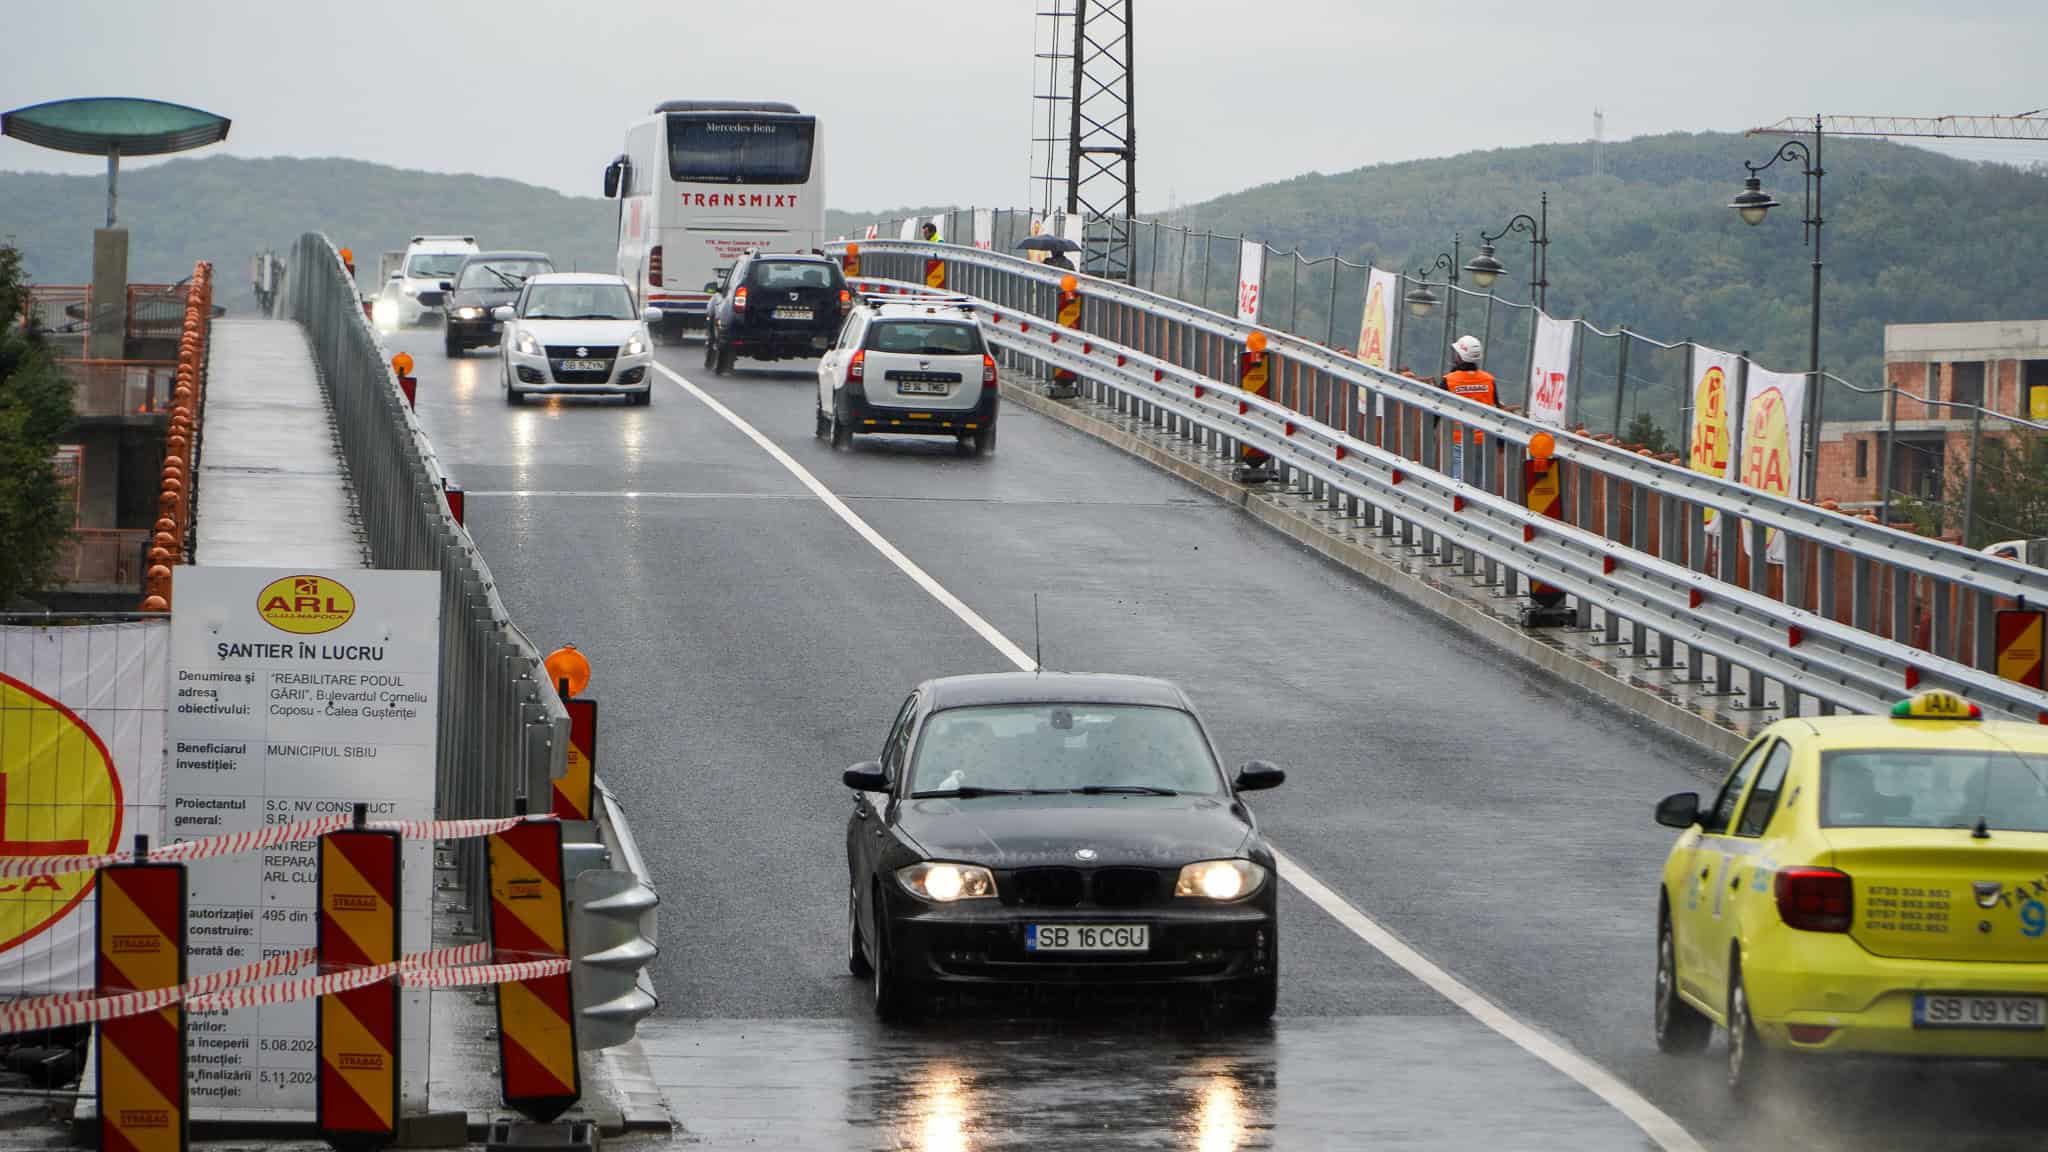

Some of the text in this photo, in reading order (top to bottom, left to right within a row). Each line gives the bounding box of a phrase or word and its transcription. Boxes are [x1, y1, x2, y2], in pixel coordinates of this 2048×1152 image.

[706, 122, 776, 134] Mercedes-Benz
[682, 192, 798, 208] TRANSMIXT
[263, 596, 349, 614] ARL
[298, 641, 316, 659] ÎN
[323, 646, 384, 661] LUCRU
[178, 671, 242, 683] Denumirea
[361, 675, 404, 687] PODUL
[178, 687, 217, 698] adresa
[316, 690, 376, 702] Bulevardul
[379, 692, 428, 703] Corneliu
[178, 703, 250, 715] obiectivului:
[270, 705, 314, 717] Coposu
[325, 705, 358, 717] Calea
[177, 743, 246, 754] Beneficiarul
[267, 745, 377, 758] MUNICIPIUL SIBIU
[175, 799, 246, 810] Proiectantul
[266, 800, 396, 814] S.C. NV CONSUCT
[174, 815, 222, 827] general:
[264, 871, 289, 882] ARL
[262, 910, 286, 921] 495
[289, 910, 308, 922] din
[189, 924, 253, 936] construire:
[1039, 927, 1069, 948] SB
[1077, 927, 1097, 948] 16
[1100, 927, 1144, 948] CGU
[226, 943, 244, 956] de:
[1929, 999, 2038, 1021] SB 09 YSI
[198, 1036, 249, 1050] începerii
